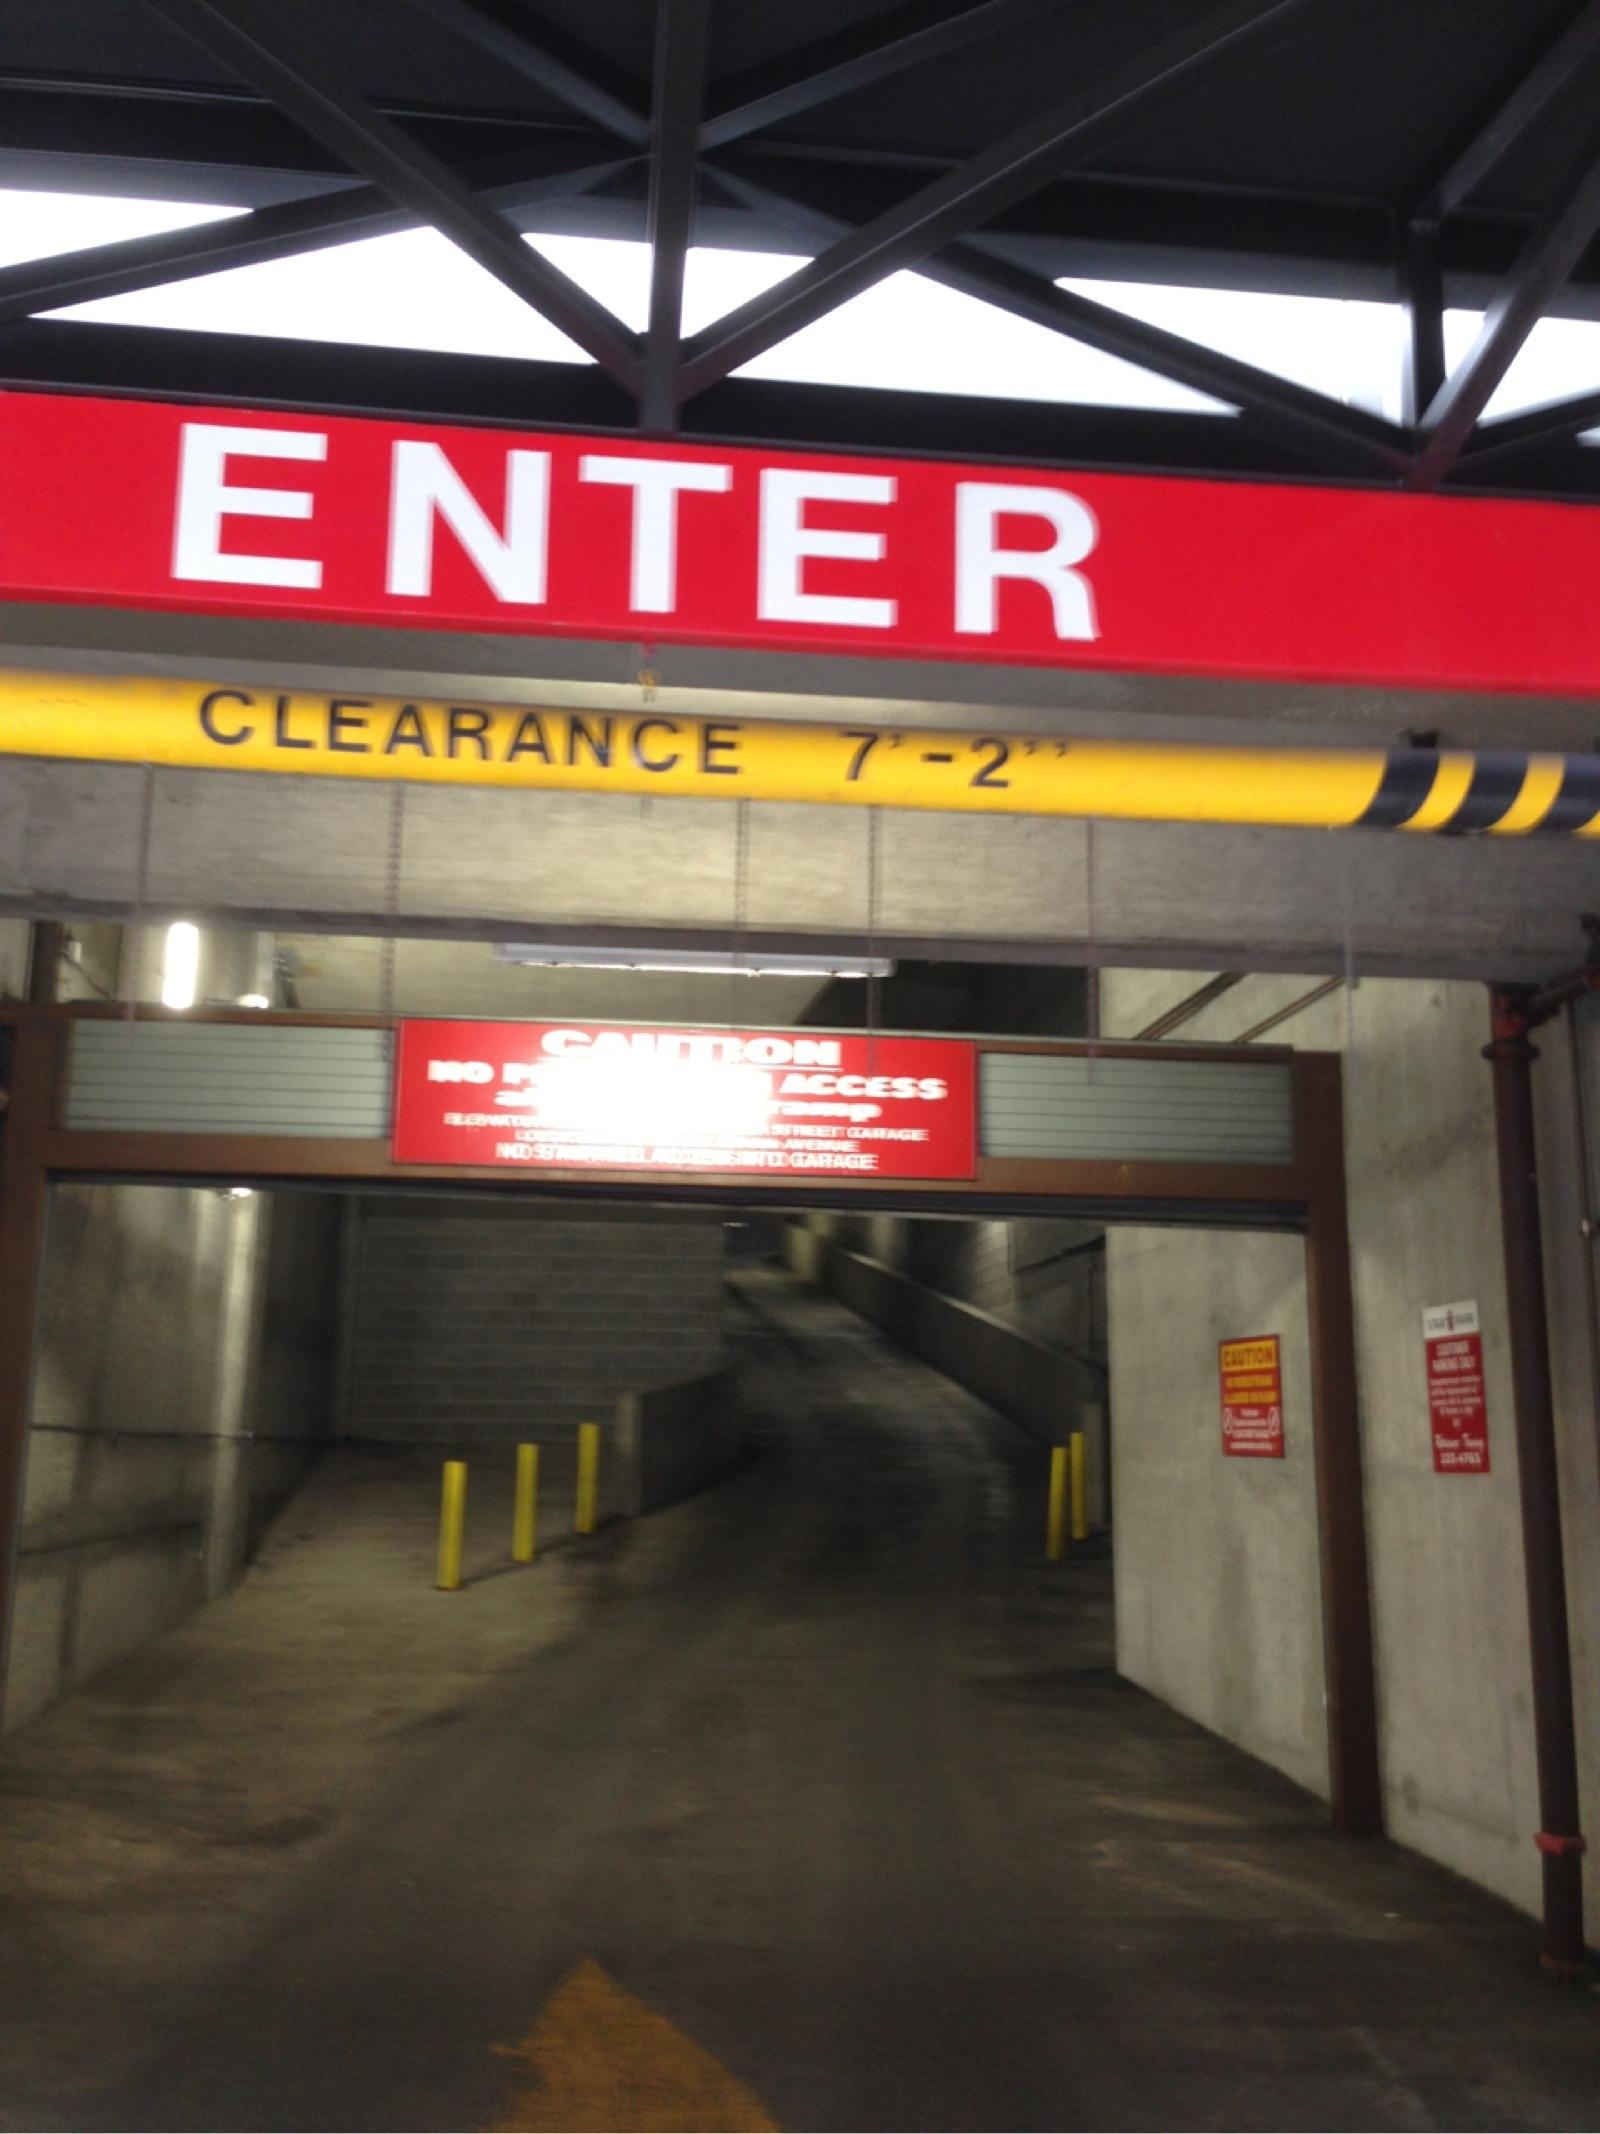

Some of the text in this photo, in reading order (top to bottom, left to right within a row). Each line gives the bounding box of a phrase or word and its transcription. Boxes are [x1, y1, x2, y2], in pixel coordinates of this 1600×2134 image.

[171, 422, 1101, 642] ENTER
[199, 686, 743, 776] CLEARANCE
[540, 1029, 842, 1068] CAUTION
[427, 1060, 495, 1084] NO
[779, 1072, 948, 1101] ACCESS
[846, 1126, 929, 1142] GARAGE
[790, 1151, 880, 1171] GARAGE
[1222, 1345, 1273, 1369] CAUTION
